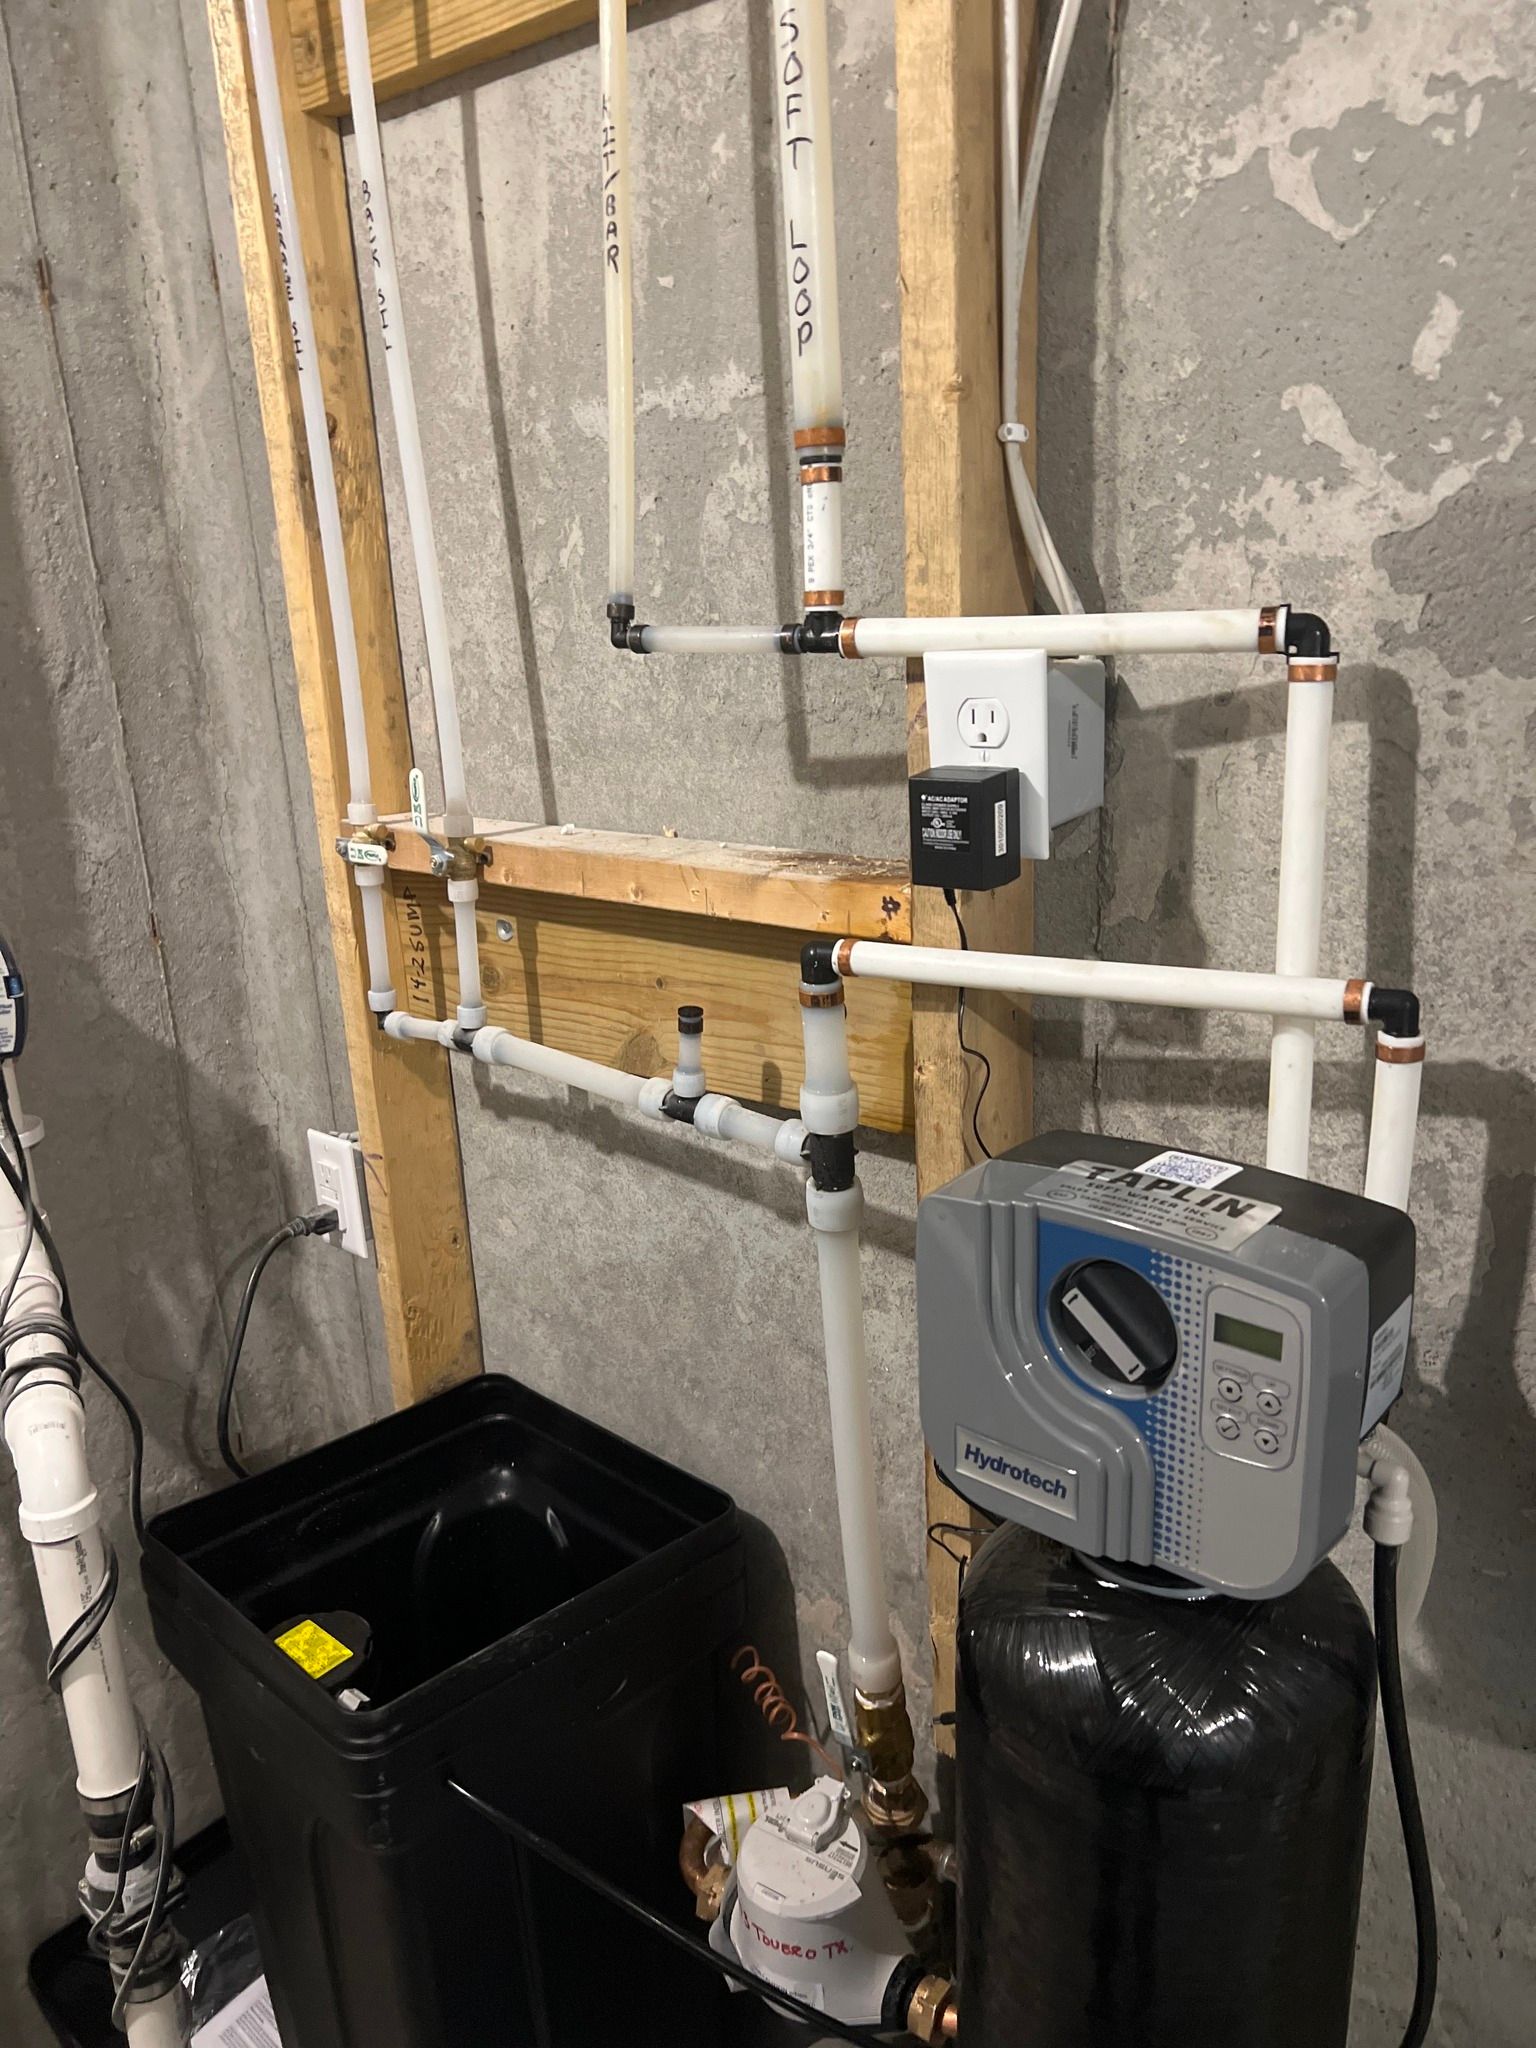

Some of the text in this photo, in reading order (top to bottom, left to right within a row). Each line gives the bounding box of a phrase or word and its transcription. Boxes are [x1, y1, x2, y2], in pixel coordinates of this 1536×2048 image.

[780, 8, 813, 357] SOFT LOOP
[1085, 1182, 1210, 1218] SOFT WATER INC
[1086, 1166, 1257, 1218] TAPLIN
[964, 1443, 1067, 1499] Hydrotech
